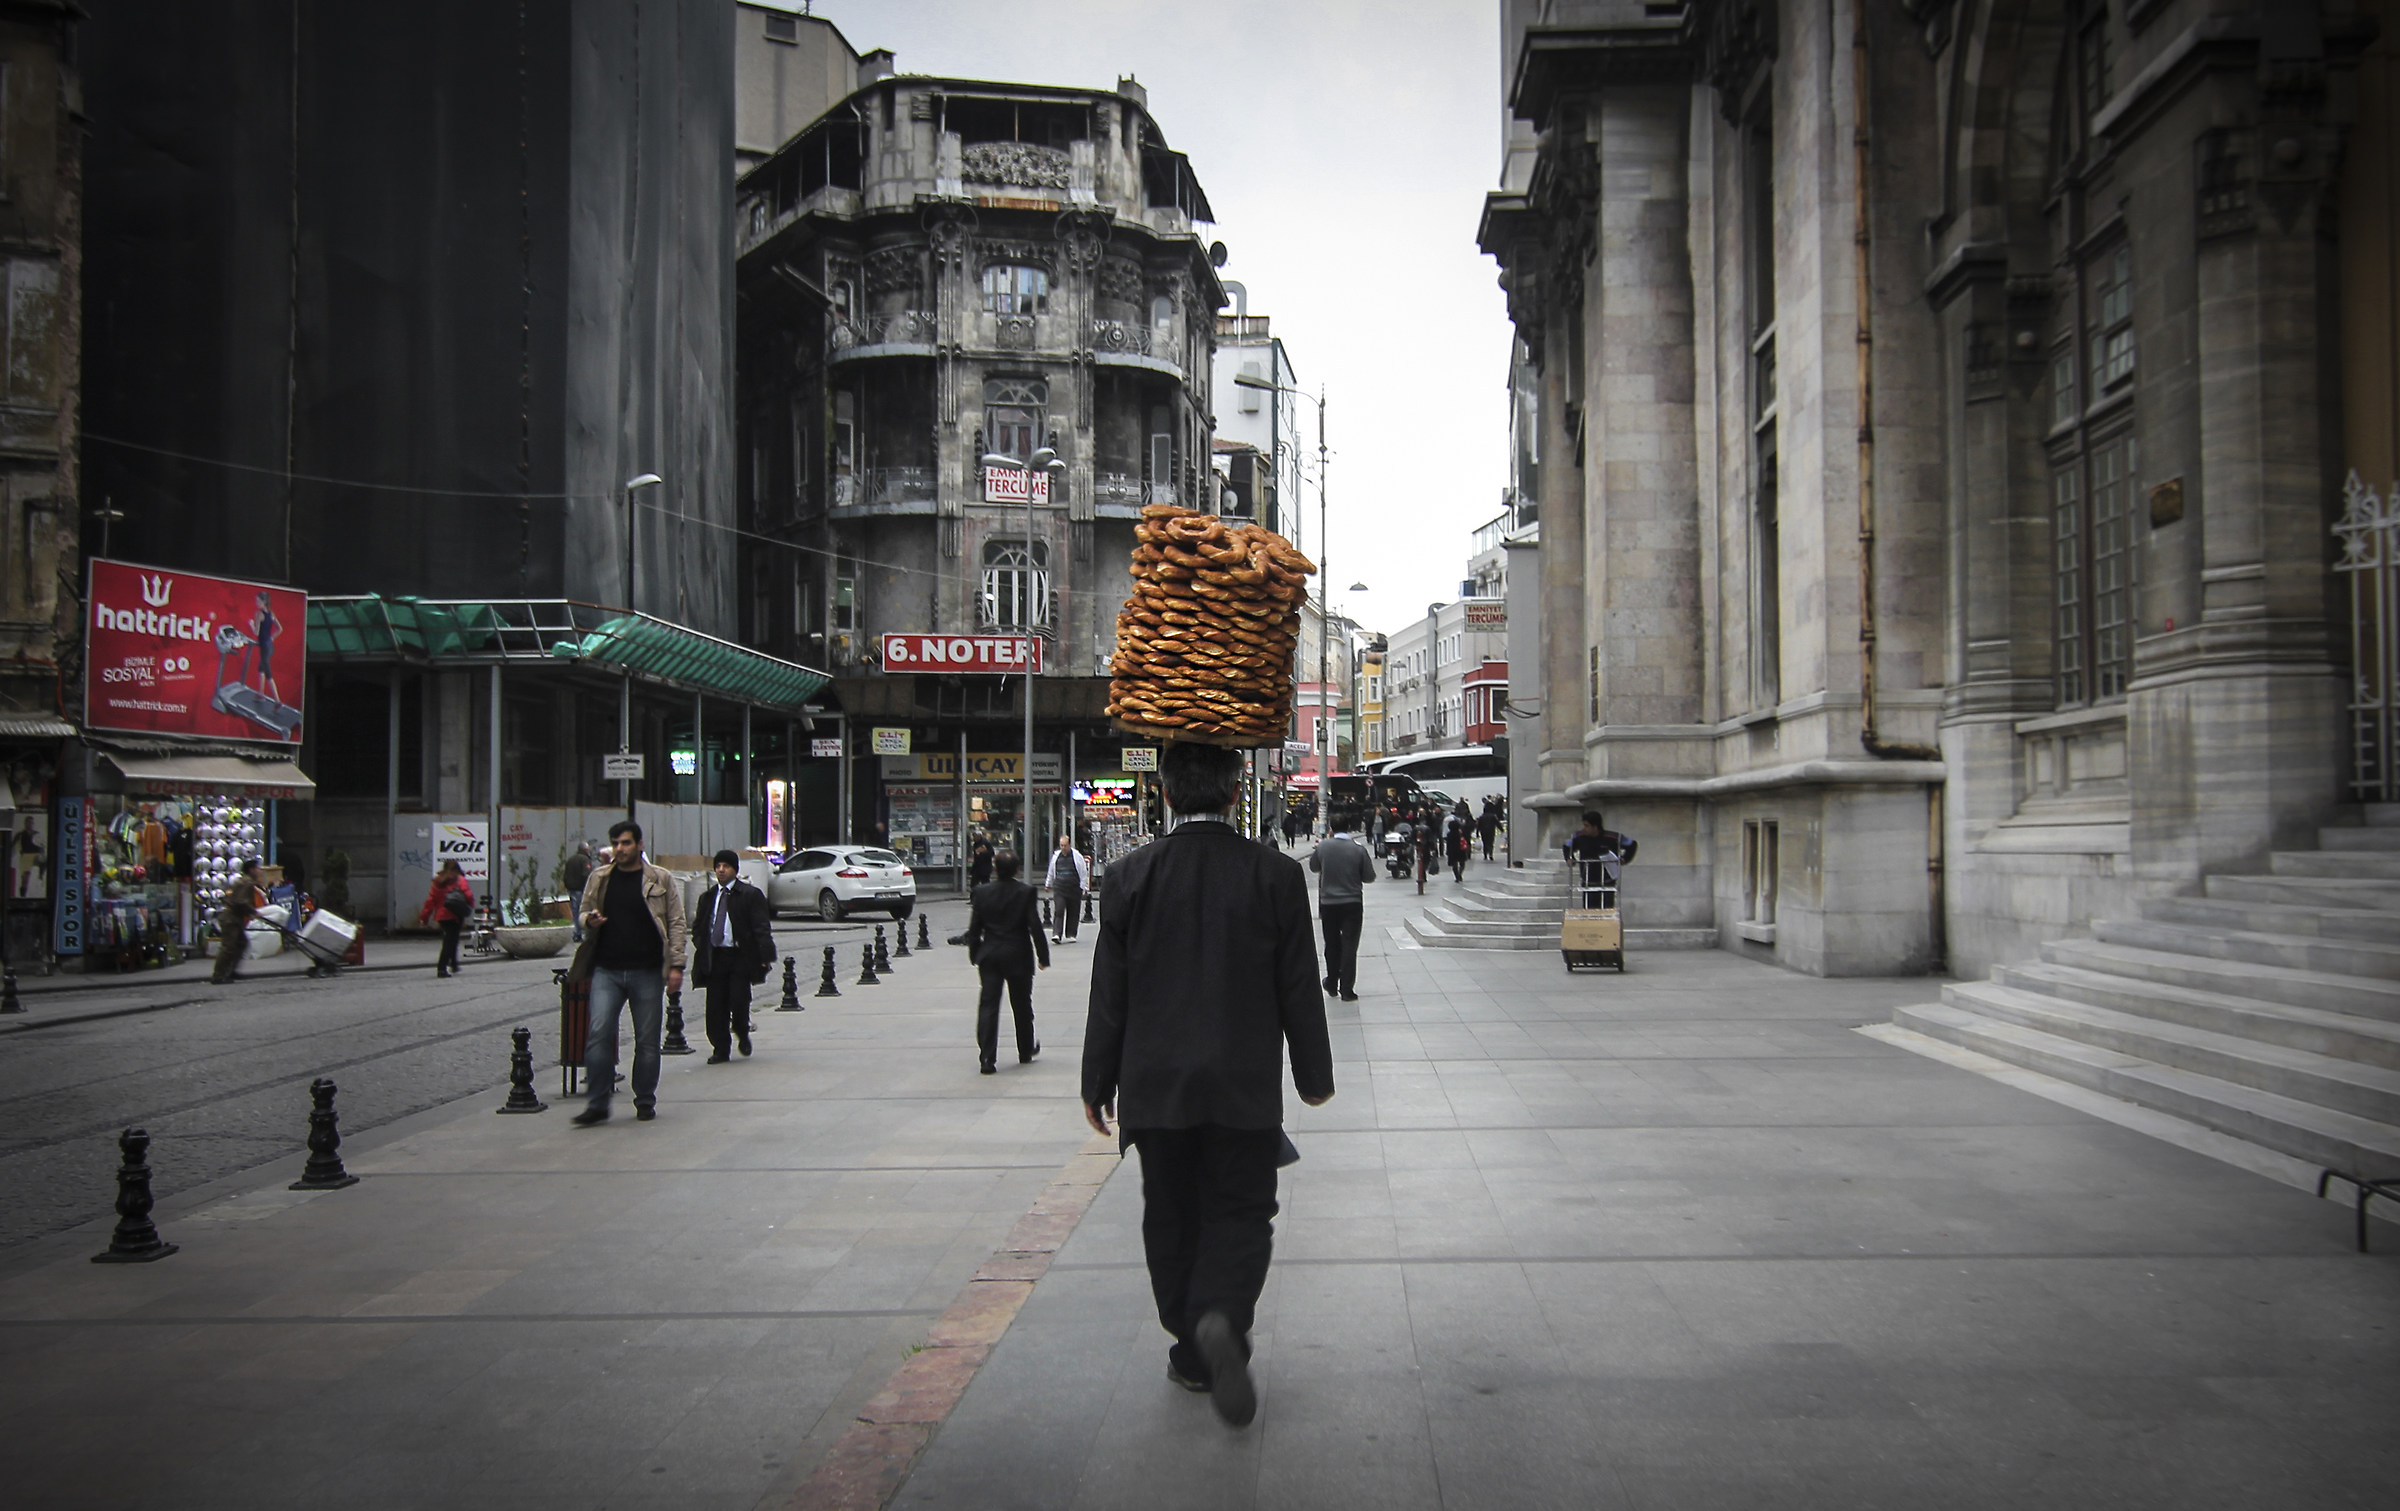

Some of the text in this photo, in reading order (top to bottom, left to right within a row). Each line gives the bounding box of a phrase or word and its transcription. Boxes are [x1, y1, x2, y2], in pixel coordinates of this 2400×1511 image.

[96, 602, 211, 642] hattrick
[921, 638, 1036, 664] NOTER
[103, 667, 155, 683] SOSYAL
[108, 698, 187, 714] www.hattrick.com.tr
[243, 785, 296, 798] SPOR
[886, 787, 928, 795] FAKS
[439, 840, 485, 852] Voit
[63, 802, 80, 948] ÜÇLER SPOR
